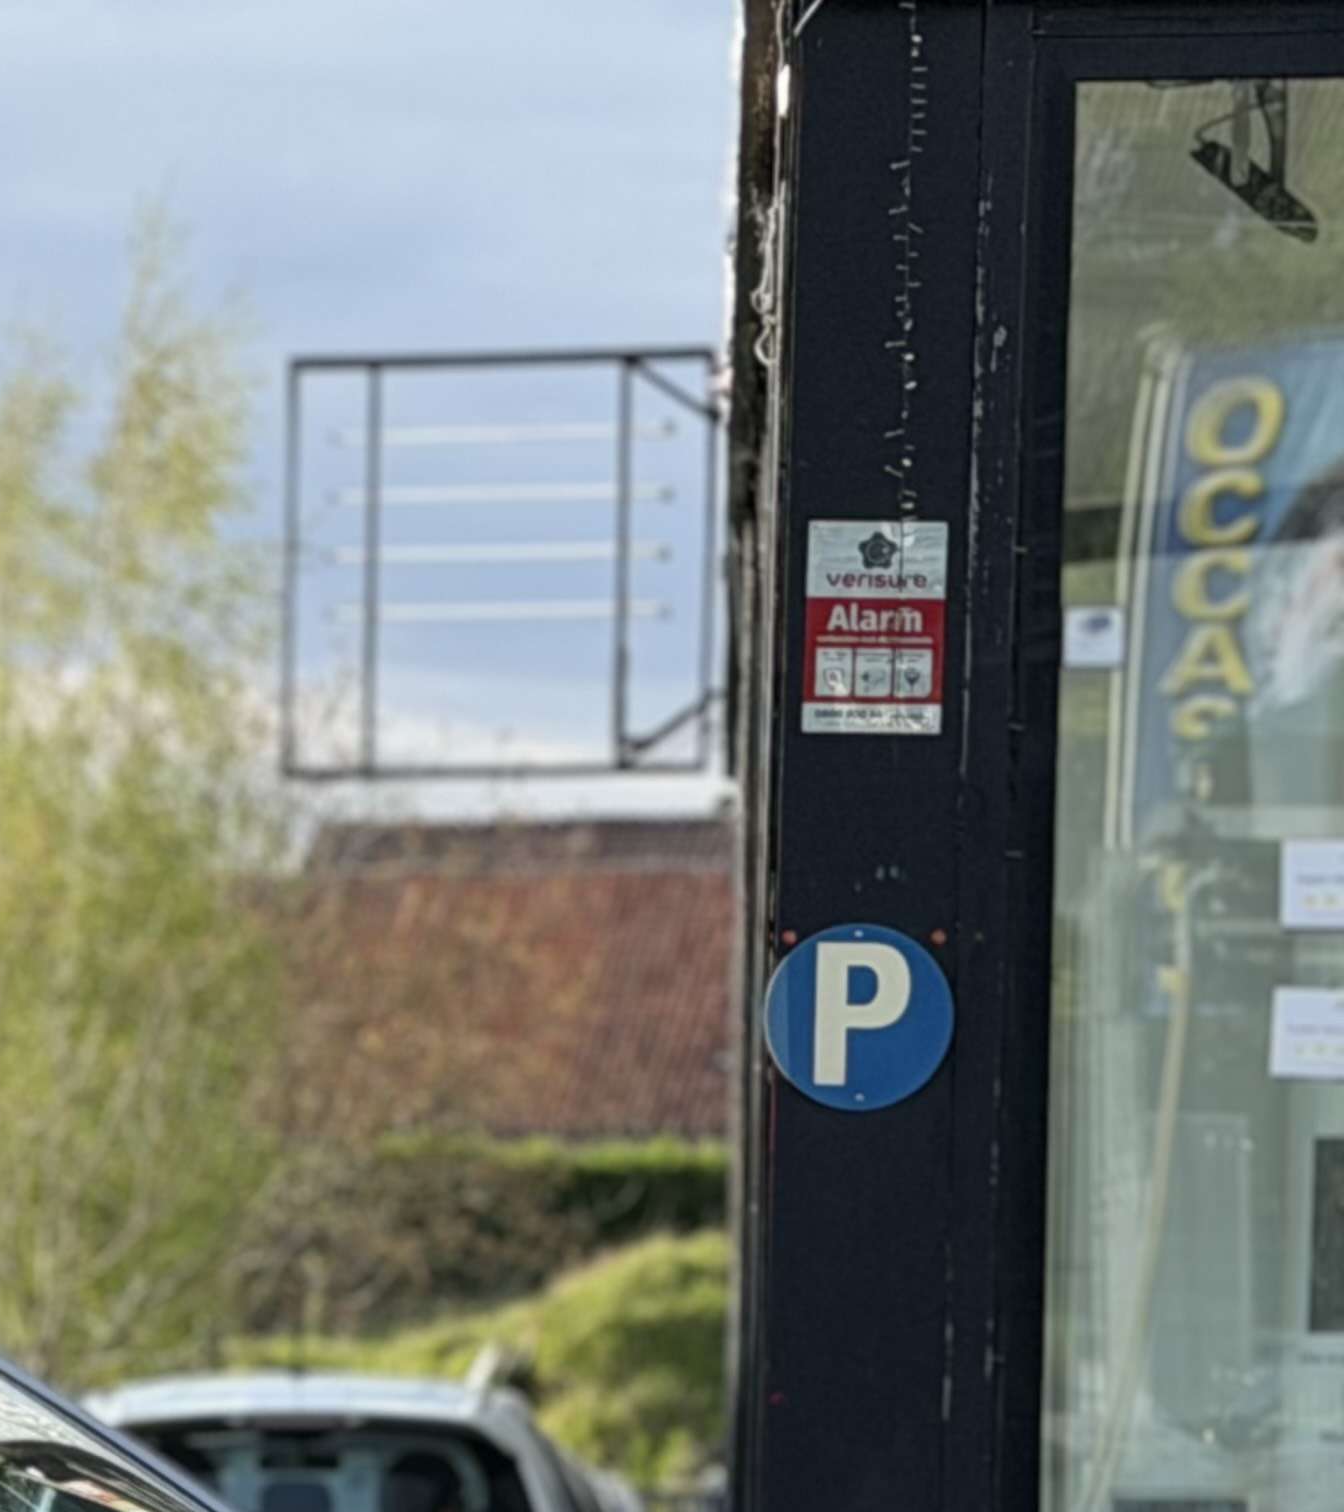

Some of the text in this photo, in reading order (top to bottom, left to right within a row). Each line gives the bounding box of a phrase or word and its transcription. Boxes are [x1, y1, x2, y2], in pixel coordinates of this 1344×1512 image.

[826, 572, 927, 588] verisure
[827, 603, 923, 632] Alarm
[814, 941, 911, 1086] P
